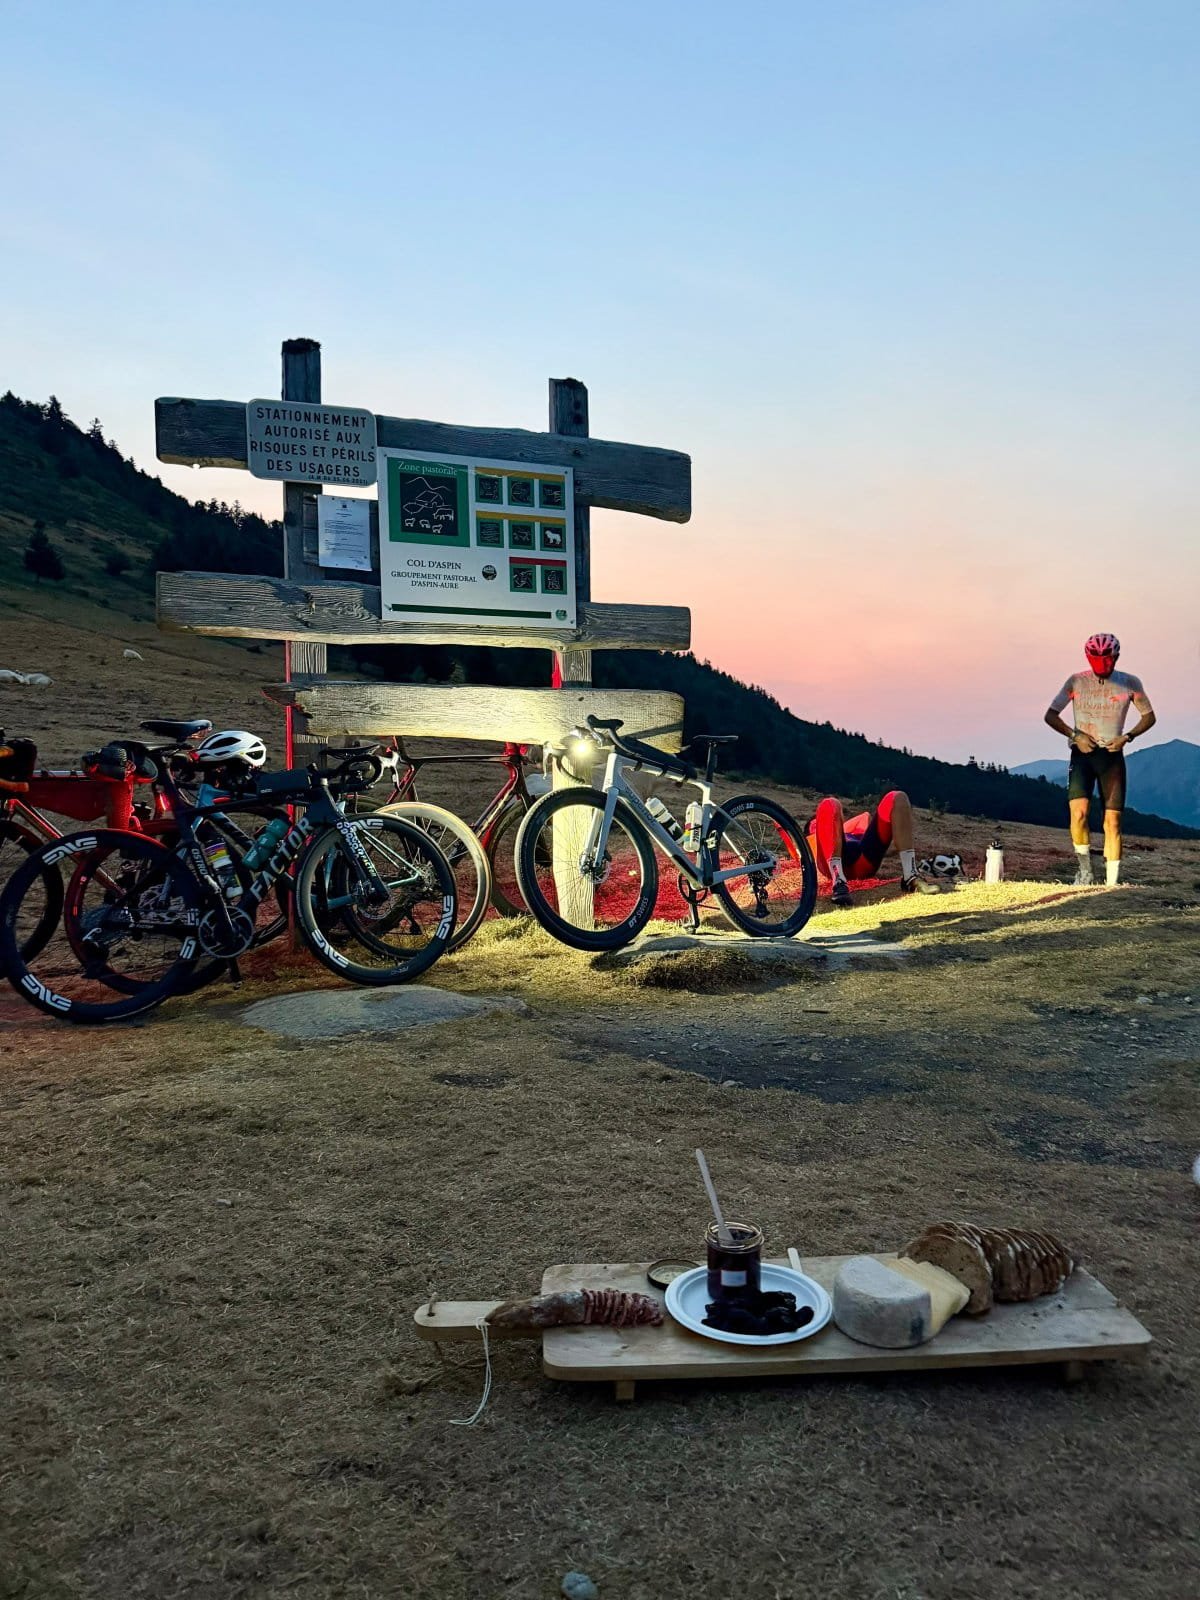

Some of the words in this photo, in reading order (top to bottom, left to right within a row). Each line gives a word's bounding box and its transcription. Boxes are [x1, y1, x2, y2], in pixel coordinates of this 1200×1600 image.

[257, 407, 367, 428] STATIONNEMENT
[264, 425, 330, 442] AUTORISÉ
[336, 432, 361, 444] AUX
[250, 441, 307, 456] RISQUES
[313, 446, 326, 458] ET
[332, 446, 375, 462] PÉRILS
[267, 459, 293, 472] DES
[299, 462, 360, 477] USAGERS
[398, 461, 420, 471] Zone
[406, 559, 427, 568] COL
[428, 560, 462, 570] D'ASPIN
[390, 570, 442, 580] GROUPEMENT
[443, 574, 478, 583] PASTORAL
[191, 848, 208, 876] OSTRO
[249, 817, 314, 900] FACTOR
